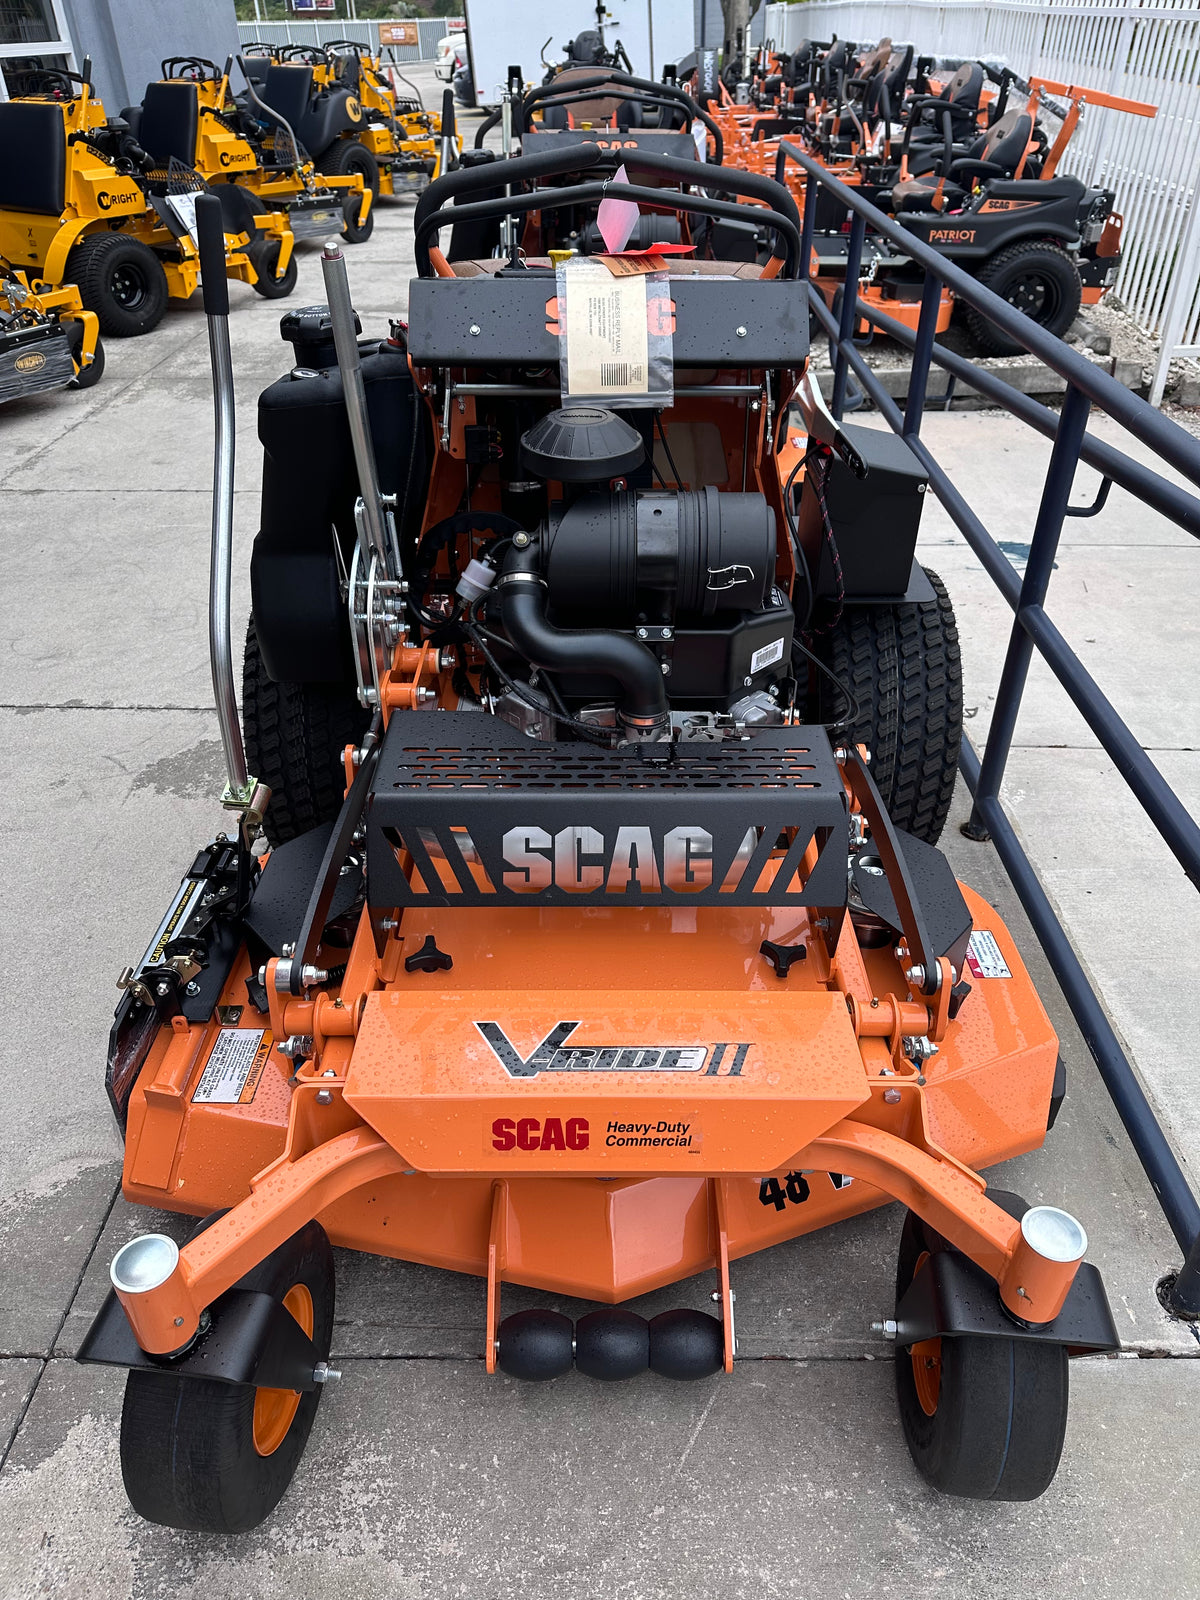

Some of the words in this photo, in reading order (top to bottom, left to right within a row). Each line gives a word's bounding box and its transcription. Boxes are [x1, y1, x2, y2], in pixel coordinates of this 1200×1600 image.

[220, 152, 251, 166] WRIGHT
[97, 191, 138, 210] WRIGHT
[988, 200, 1011, 210] SCAG
[929, 229, 977, 243] PATRIOT
[502, 826, 713, 894] SCAG
[150, 933, 171, 963] CAUTION
[218, 1048, 229, 1065] OPERATE
[472, 1021, 708, 1078] V-RIDE
[699, 1042, 756, 1077] II
[243, 1055, 253, 1071] BLADES
[245, 1051, 265, 1086] WARNING
[233, 1083, 243, 1096] BELTS
[492, 1117, 590, 1151] SCAG
[606, 1121, 690, 1135] Heavy-Duty
[605, 1135, 692, 1147] Commercial
